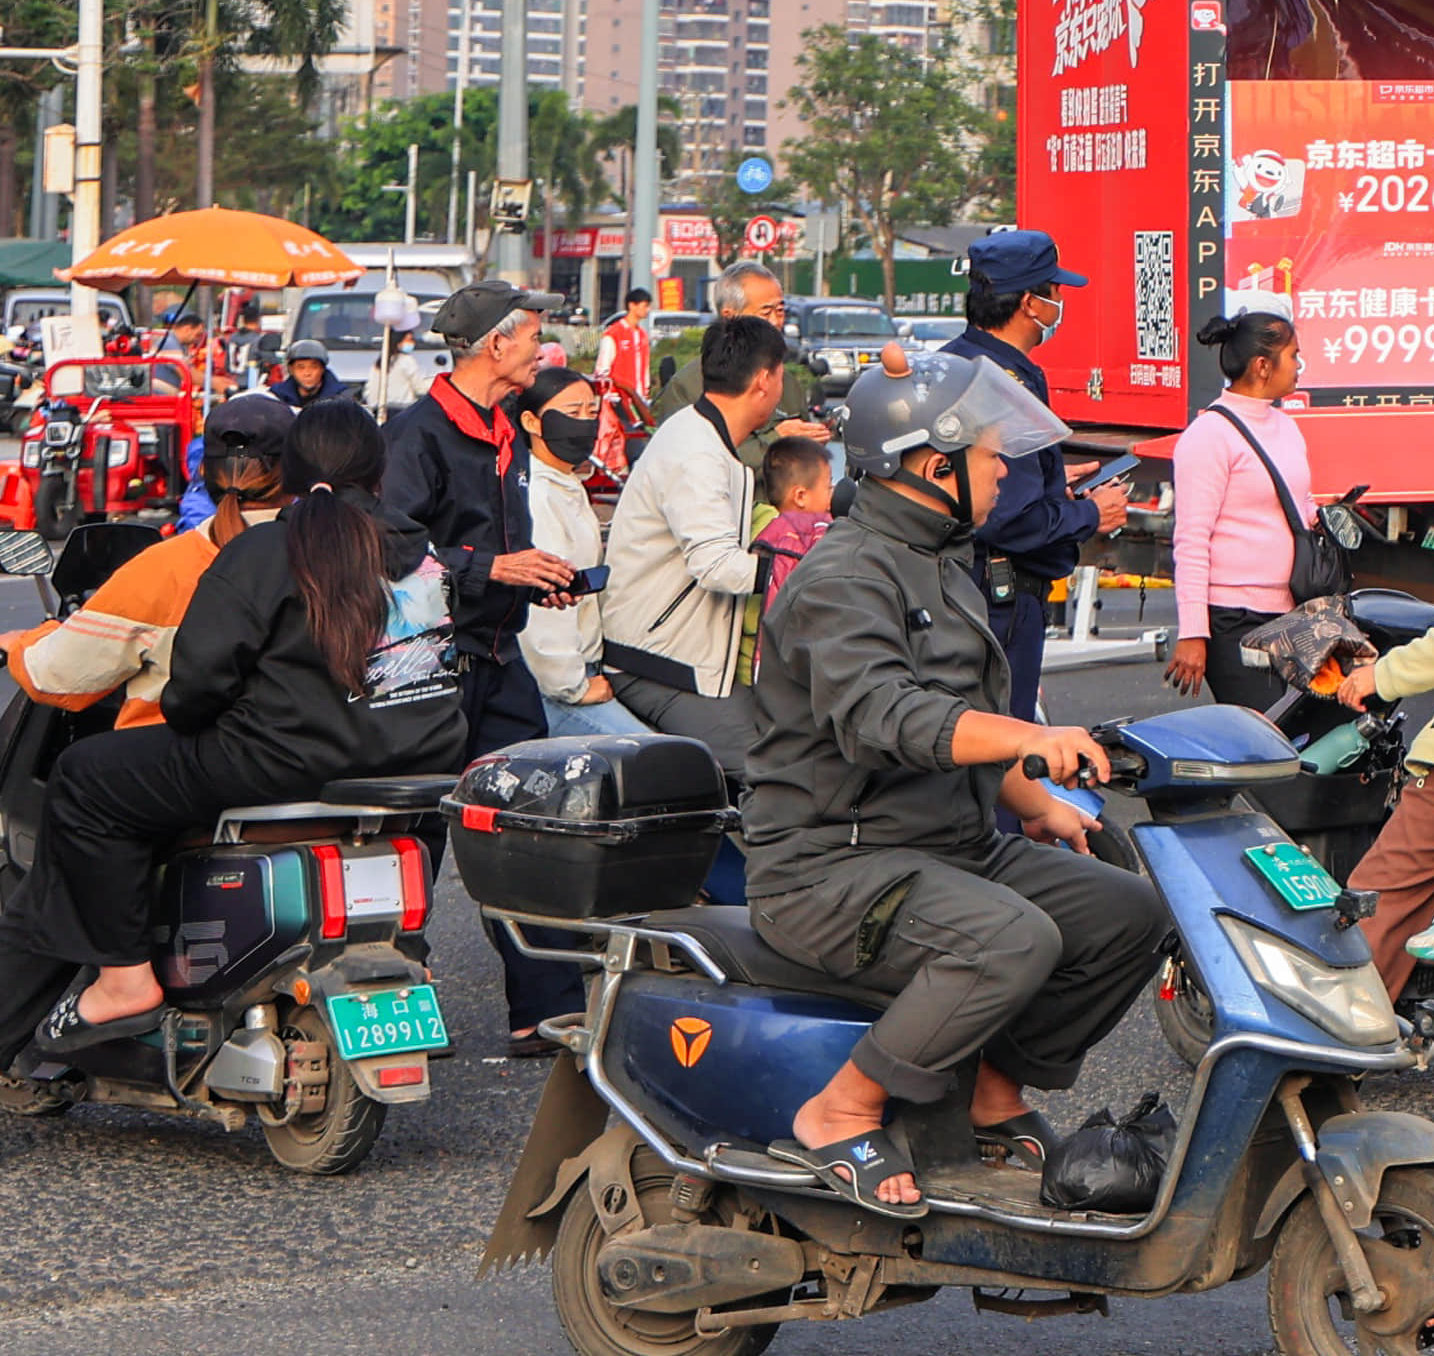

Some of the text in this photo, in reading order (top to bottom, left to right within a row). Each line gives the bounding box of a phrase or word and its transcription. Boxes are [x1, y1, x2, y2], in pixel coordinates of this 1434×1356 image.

[1193, 61, 1221, 301] 打开京东APP
[343, 1017, 442, 1051] 1289912
